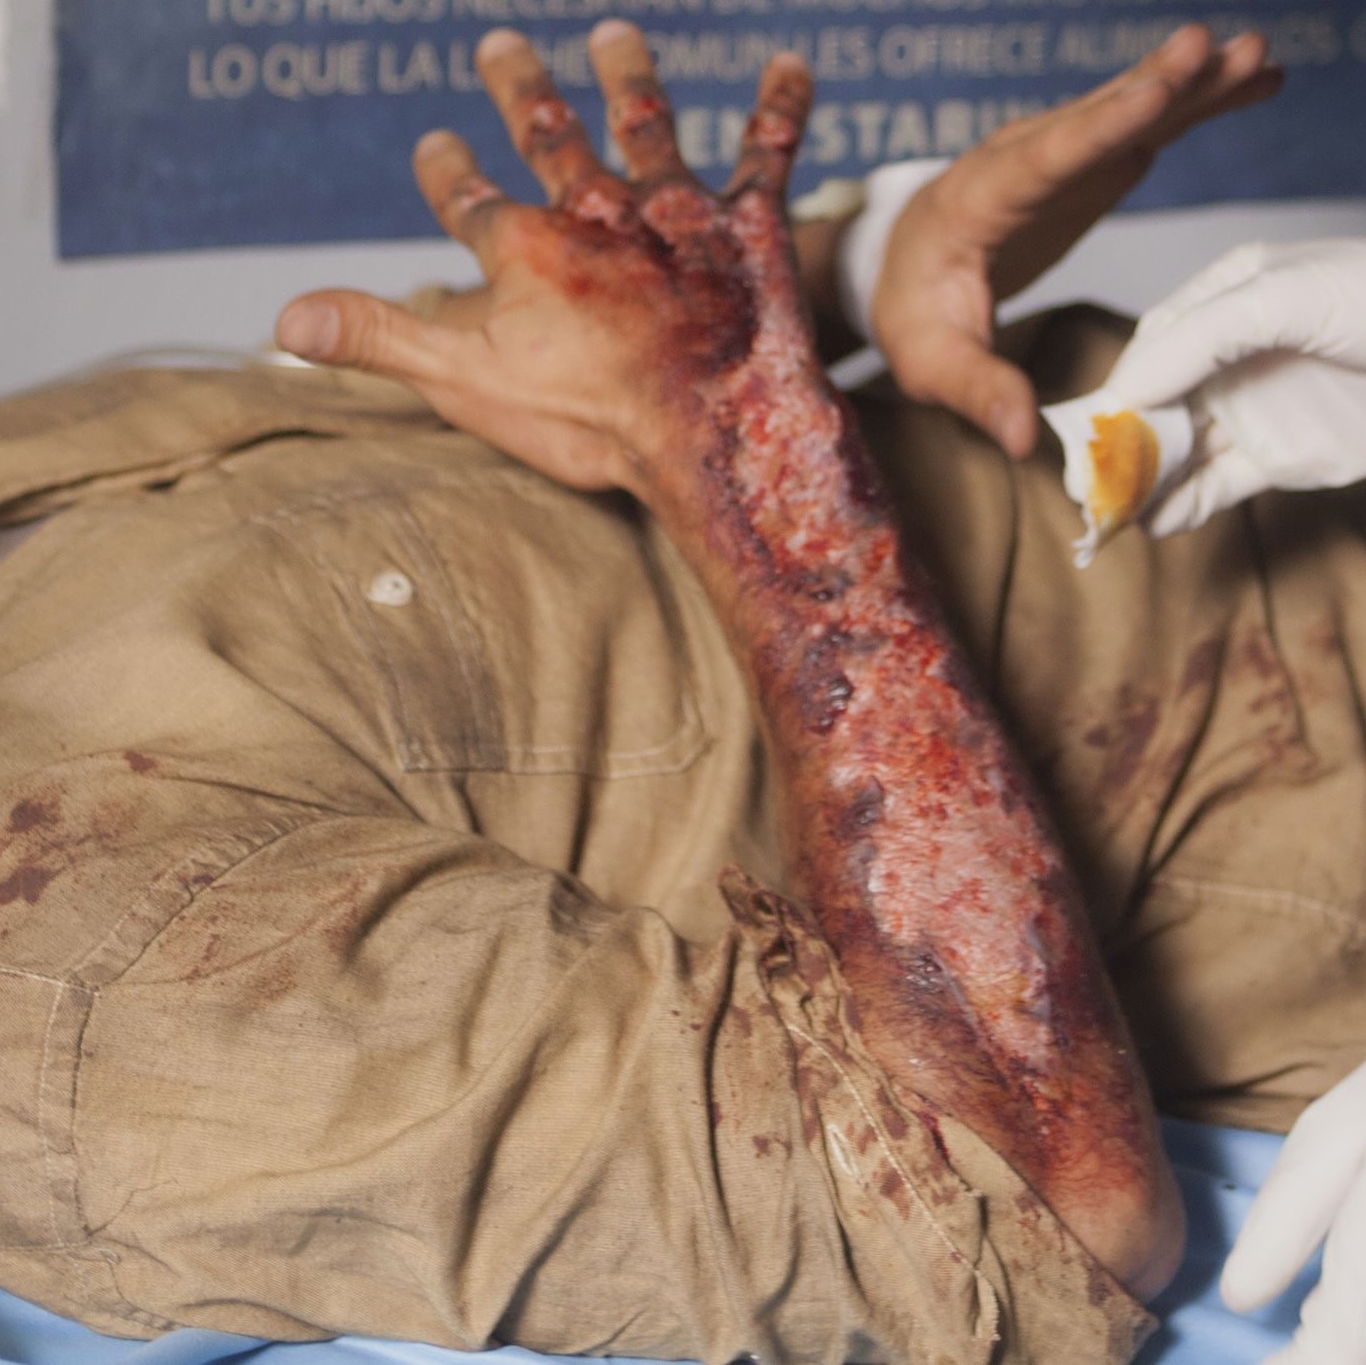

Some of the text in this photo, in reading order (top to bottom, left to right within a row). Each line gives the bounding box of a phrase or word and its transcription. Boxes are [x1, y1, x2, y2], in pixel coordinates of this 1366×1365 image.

[186, 39, 260, 101] LO
[262, 40, 373, 101] QUE
[376, 36, 448, 97] LA
[449, 34, 593, 93] LHE
[638, 25, 787, 85] OMUN
[878, 22, 1046, 81] OFRECE
